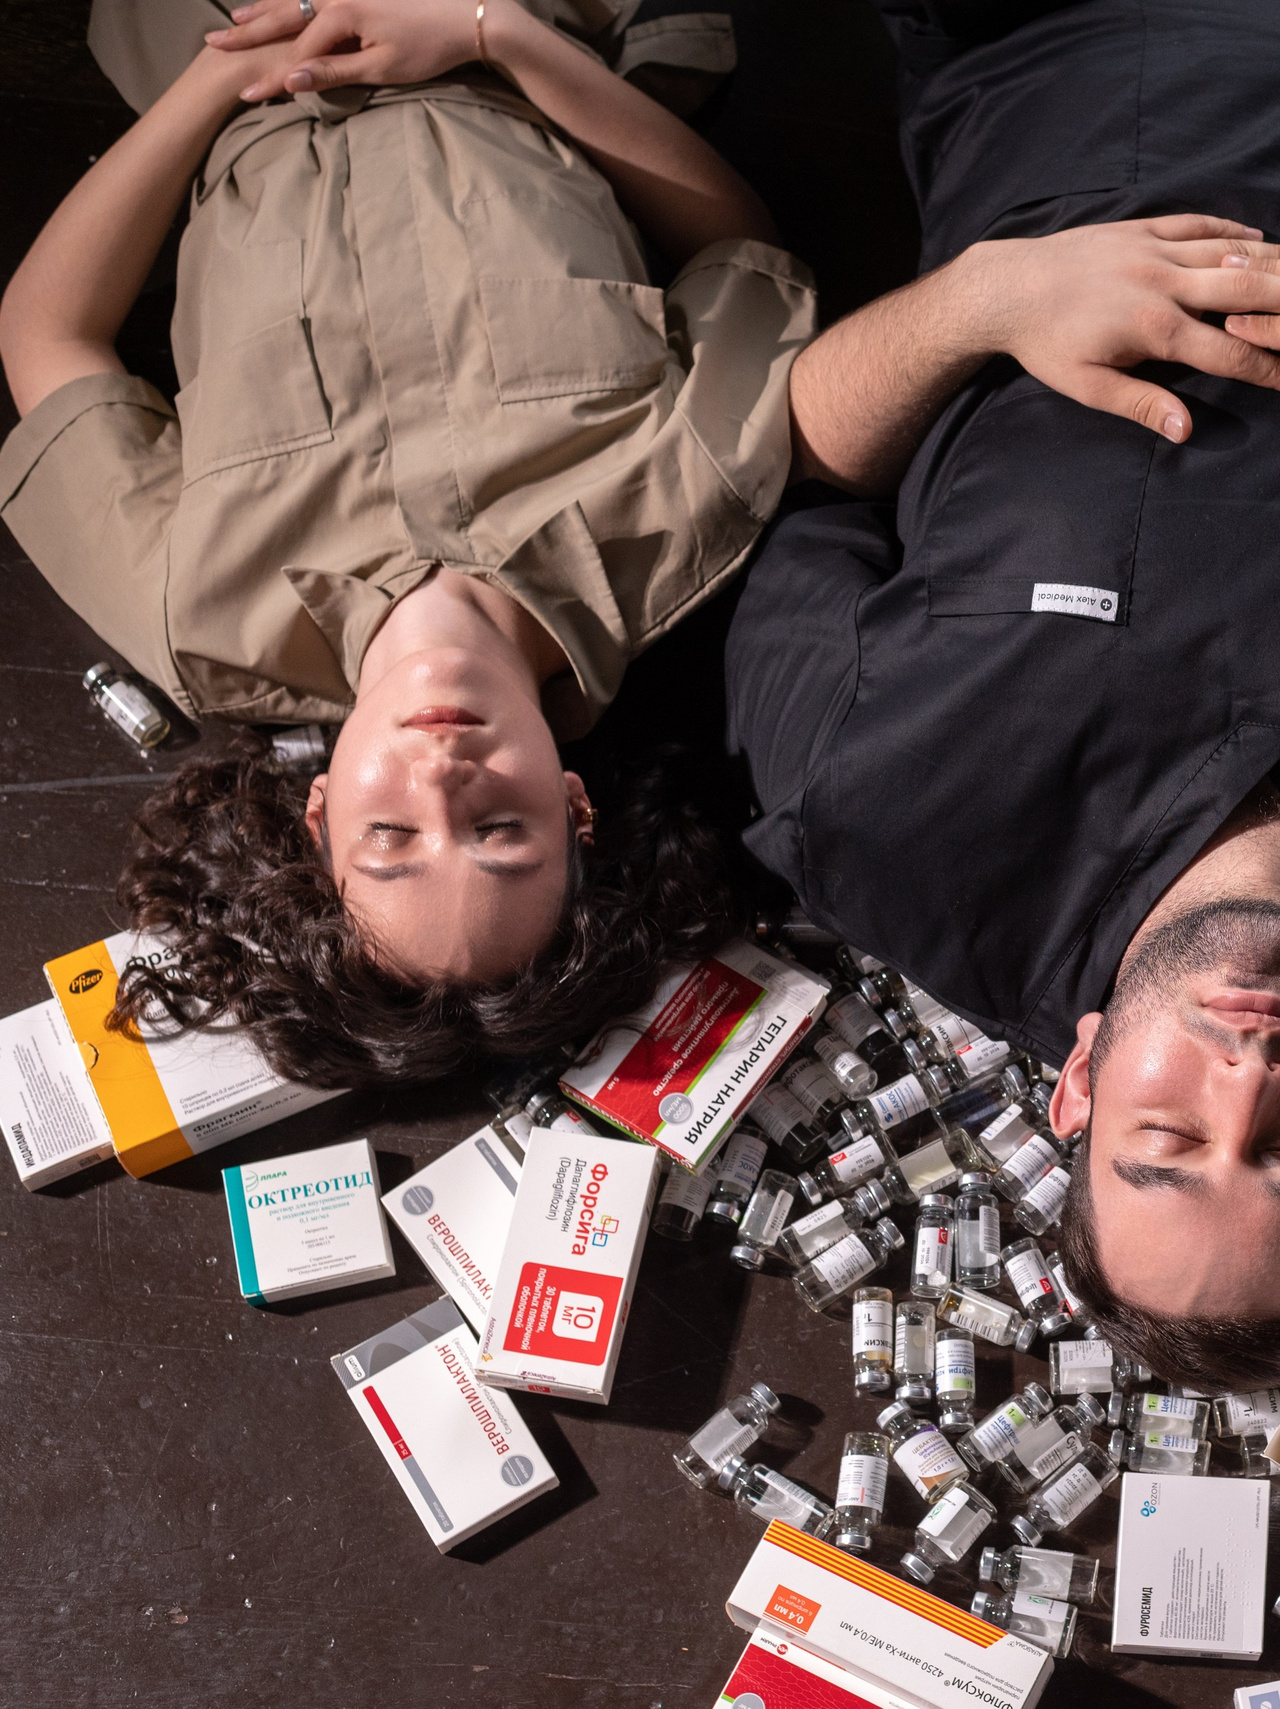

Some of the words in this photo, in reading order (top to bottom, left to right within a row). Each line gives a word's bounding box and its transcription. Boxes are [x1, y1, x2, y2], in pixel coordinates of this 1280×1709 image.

[1037, 592, 1073, 604] Medical
[1076, 595, 1096, 606] Alex
[68, 968, 105, 996] Pfizer
[670, 1012, 704, 1054] действия
[729, 1013, 787, 1085] ГЕПАРИН
[650, 1056, 685, 1098] средство
[682, 1082, 736, 1146] НАТРИЯ
[10, 1122, 35, 1168] ИНДАПАМИД
[246, 1169, 373, 1212] ОКТРЕОТИД
[545, 1156, 571, 1221] (Dapagliflozin)
[559, 1158, 585, 1232] Дапаглифлозин
[268, 1204, 294, 1217] раствор
[295, 1202, 307, 1211] для
[570, 1161, 606, 1256] Форсига
[426, 1212, 496, 1302] ВЕРОШПИЛАК
[528, 1266, 548, 1307] покрытых
[543, 1285, 556, 1296] 30
[513, 1285, 532, 1328] оболочкой
[534, 1296, 553, 1333] таблеток,
[559, 1304, 573, 1324] мг
[572, 1304, 596, 1330] 10
[519, 1308, 539, 1350] пленочной
[1149, 1482, 1158, 1505] OZON
[771, 1601, 789, 1617] мл
[786, 1609, 805, 1626] 0,4
[837, 1618, 854, 1634] мл
[1139, 1586, 1153, 1636] ФУРОСЕМИД
[1013, 1638, 1043, 1658] ALFASIGMA
[919, 1659, 945, 1679] 4250
